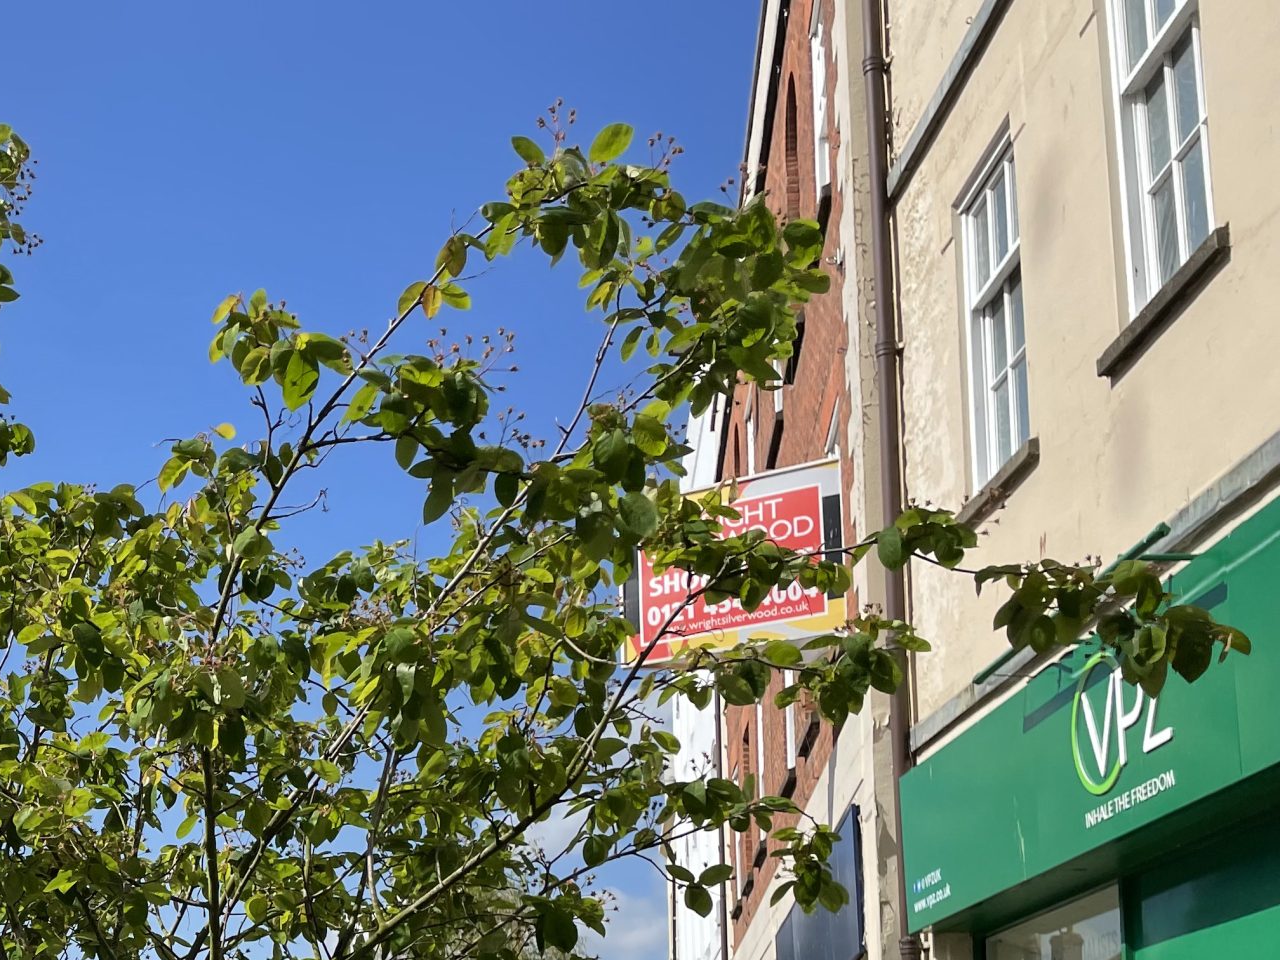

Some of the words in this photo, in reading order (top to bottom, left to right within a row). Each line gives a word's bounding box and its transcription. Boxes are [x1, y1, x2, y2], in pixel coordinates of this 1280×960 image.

[647, 601, 695, 626] 0121
[664, 600, 810, 633] ww.wrightsilverwood.co.uk
[1084, 801, 1114, 829] INHALE
[1114, 791, 1131, 814] THE
[1130, 769, 1175, 806] FREEDOM
